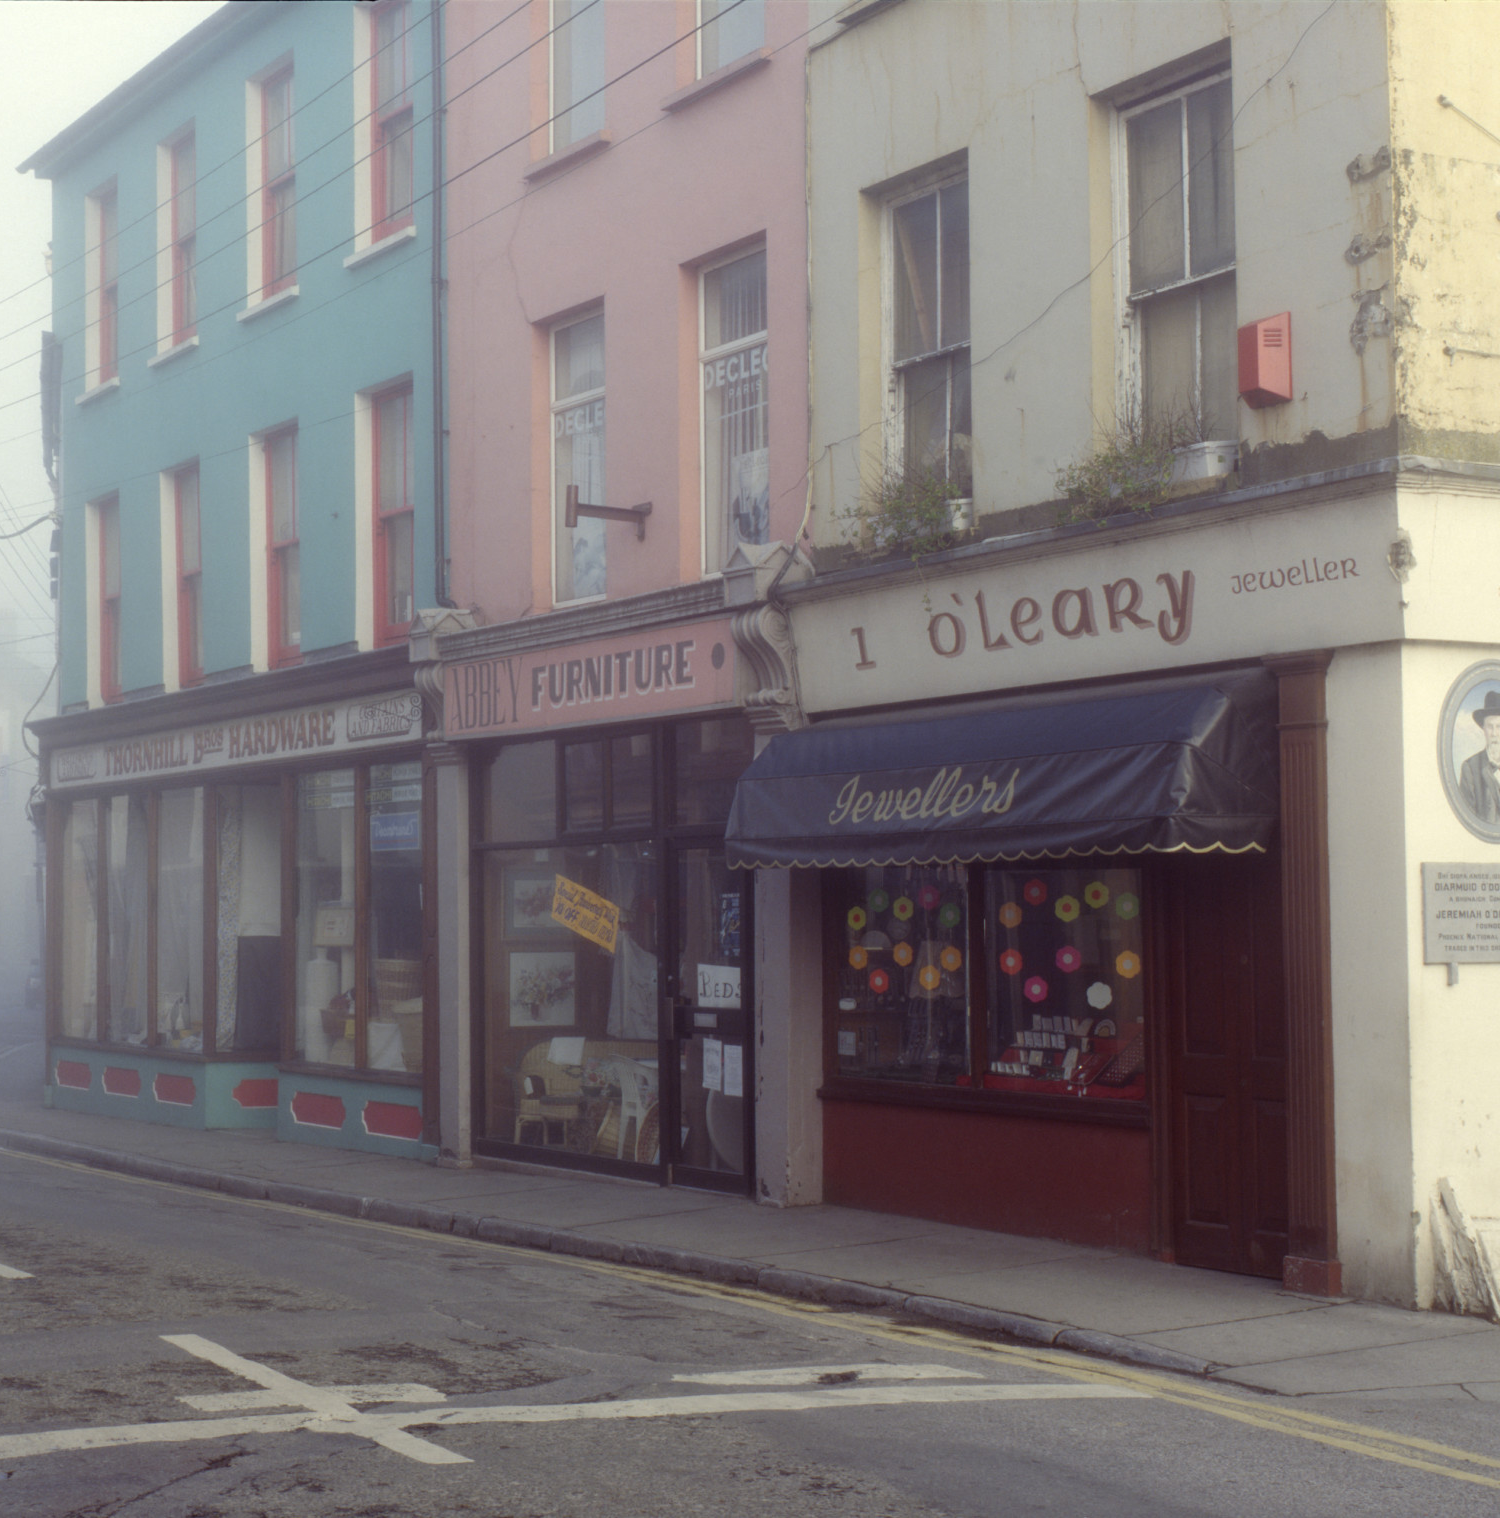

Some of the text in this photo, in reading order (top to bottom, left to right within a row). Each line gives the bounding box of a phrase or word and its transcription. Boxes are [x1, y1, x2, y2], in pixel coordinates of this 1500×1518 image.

[729, 378, 762, 399] PARIS
[451, 640, 697, 731] ABBEY FURNITURE
[104, 733, 188, 776] THORNHILL
[229, 708, 336, 760] HARDWARE
[829, 766, 1021, 825] Jewellers
[1435, 882, 1477, 893] DIARMUID
[1436, 910, 1482, 919] JEREMIAH
